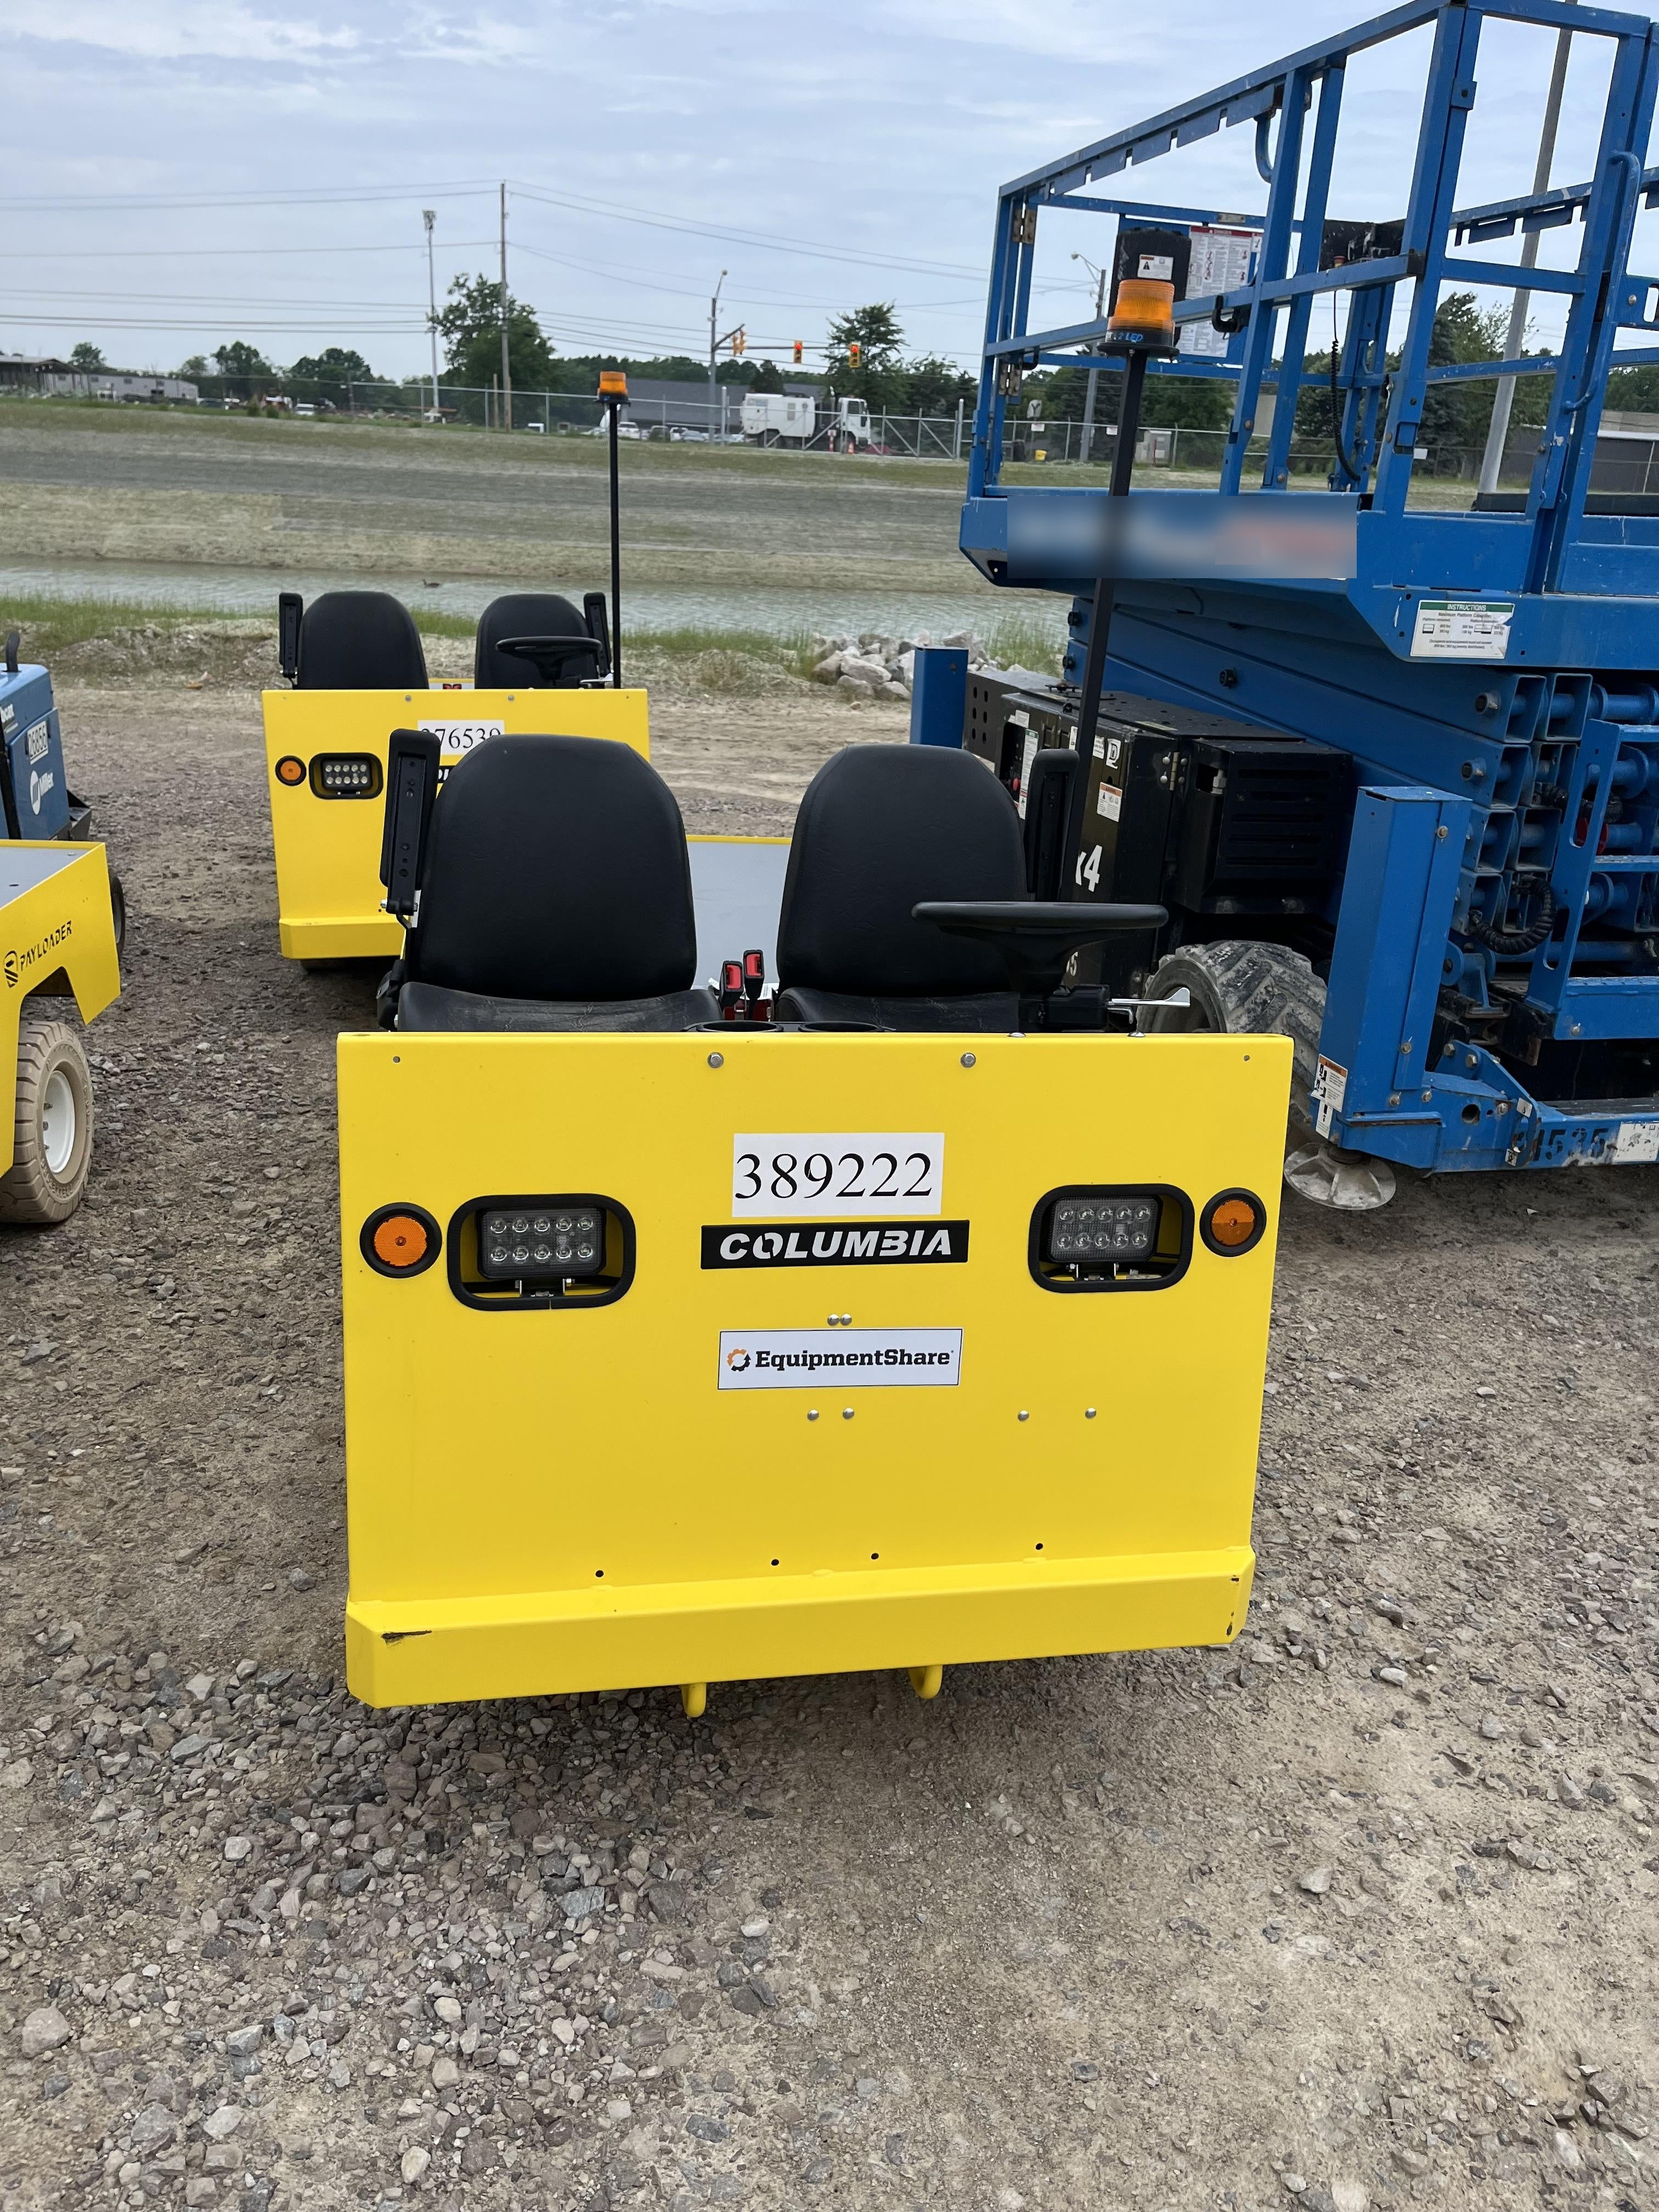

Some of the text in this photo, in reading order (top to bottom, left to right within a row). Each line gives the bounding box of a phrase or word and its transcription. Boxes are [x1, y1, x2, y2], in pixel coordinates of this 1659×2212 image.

[20, 920, 72, 972] PAYLOADER
[735, 1153, 932, 1199] 389222
[720, 1229, 951, 1260] COLUMBIA
[755, 1349, 951, 1371] EquipmentShare
